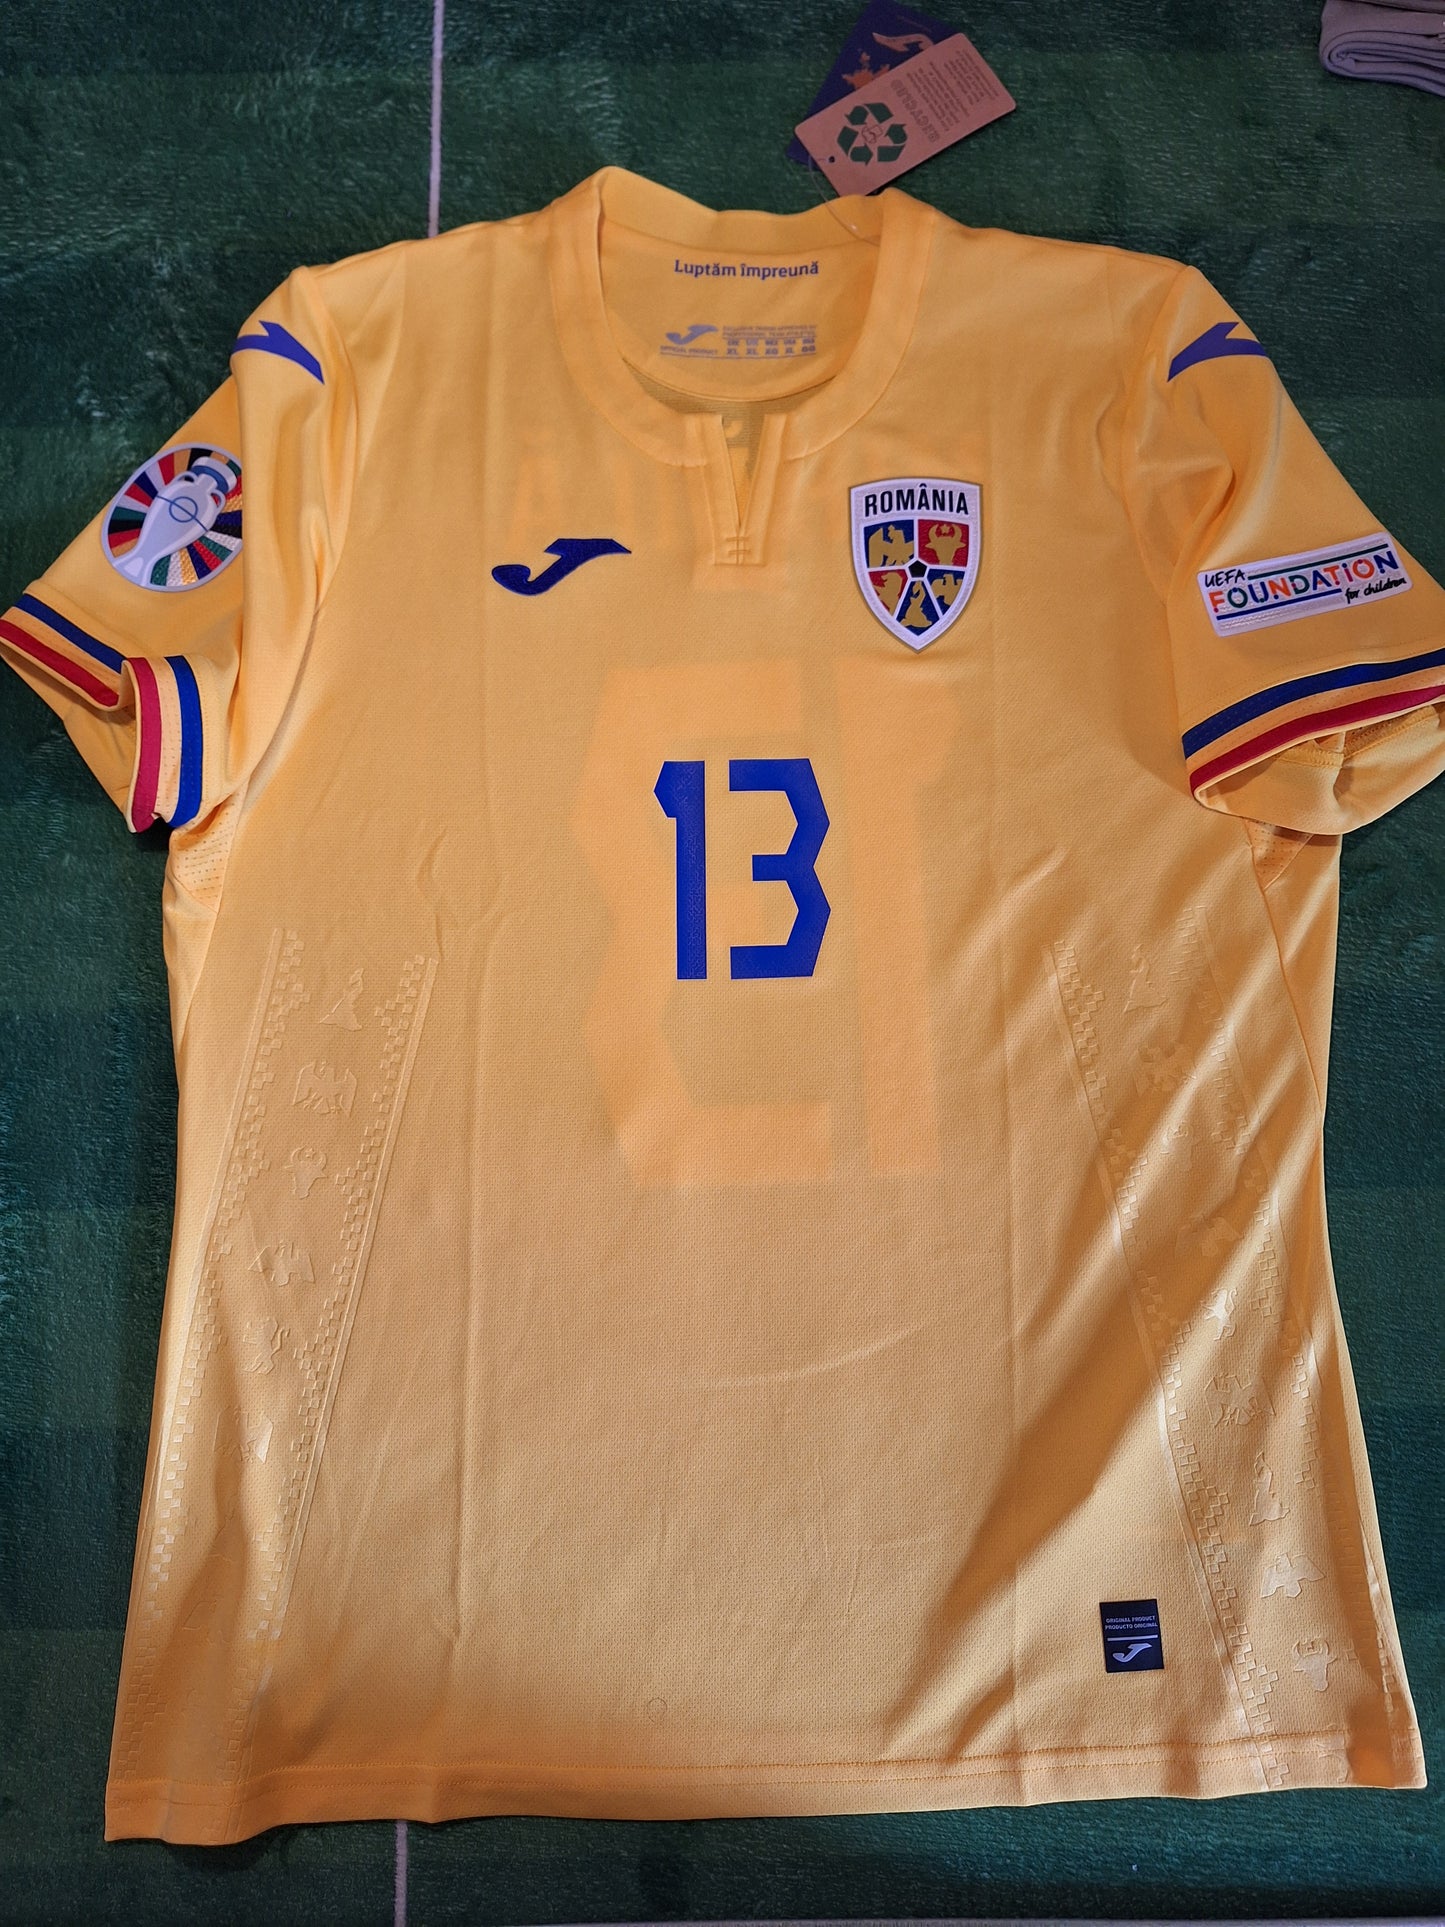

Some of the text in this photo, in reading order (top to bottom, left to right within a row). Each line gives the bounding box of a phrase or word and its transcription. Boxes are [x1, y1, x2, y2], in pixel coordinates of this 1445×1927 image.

[674, 259, 819, 281] Luptăm împreună
[864, 483, 969, 518] ROMÂNIA
[1204, 568, 1246, 588] UEFA
[1208, 550, 1399, 613] FOUNDATION
[1345, 577, 1407, 604] for children
[653, 758, 831, 981] 13
